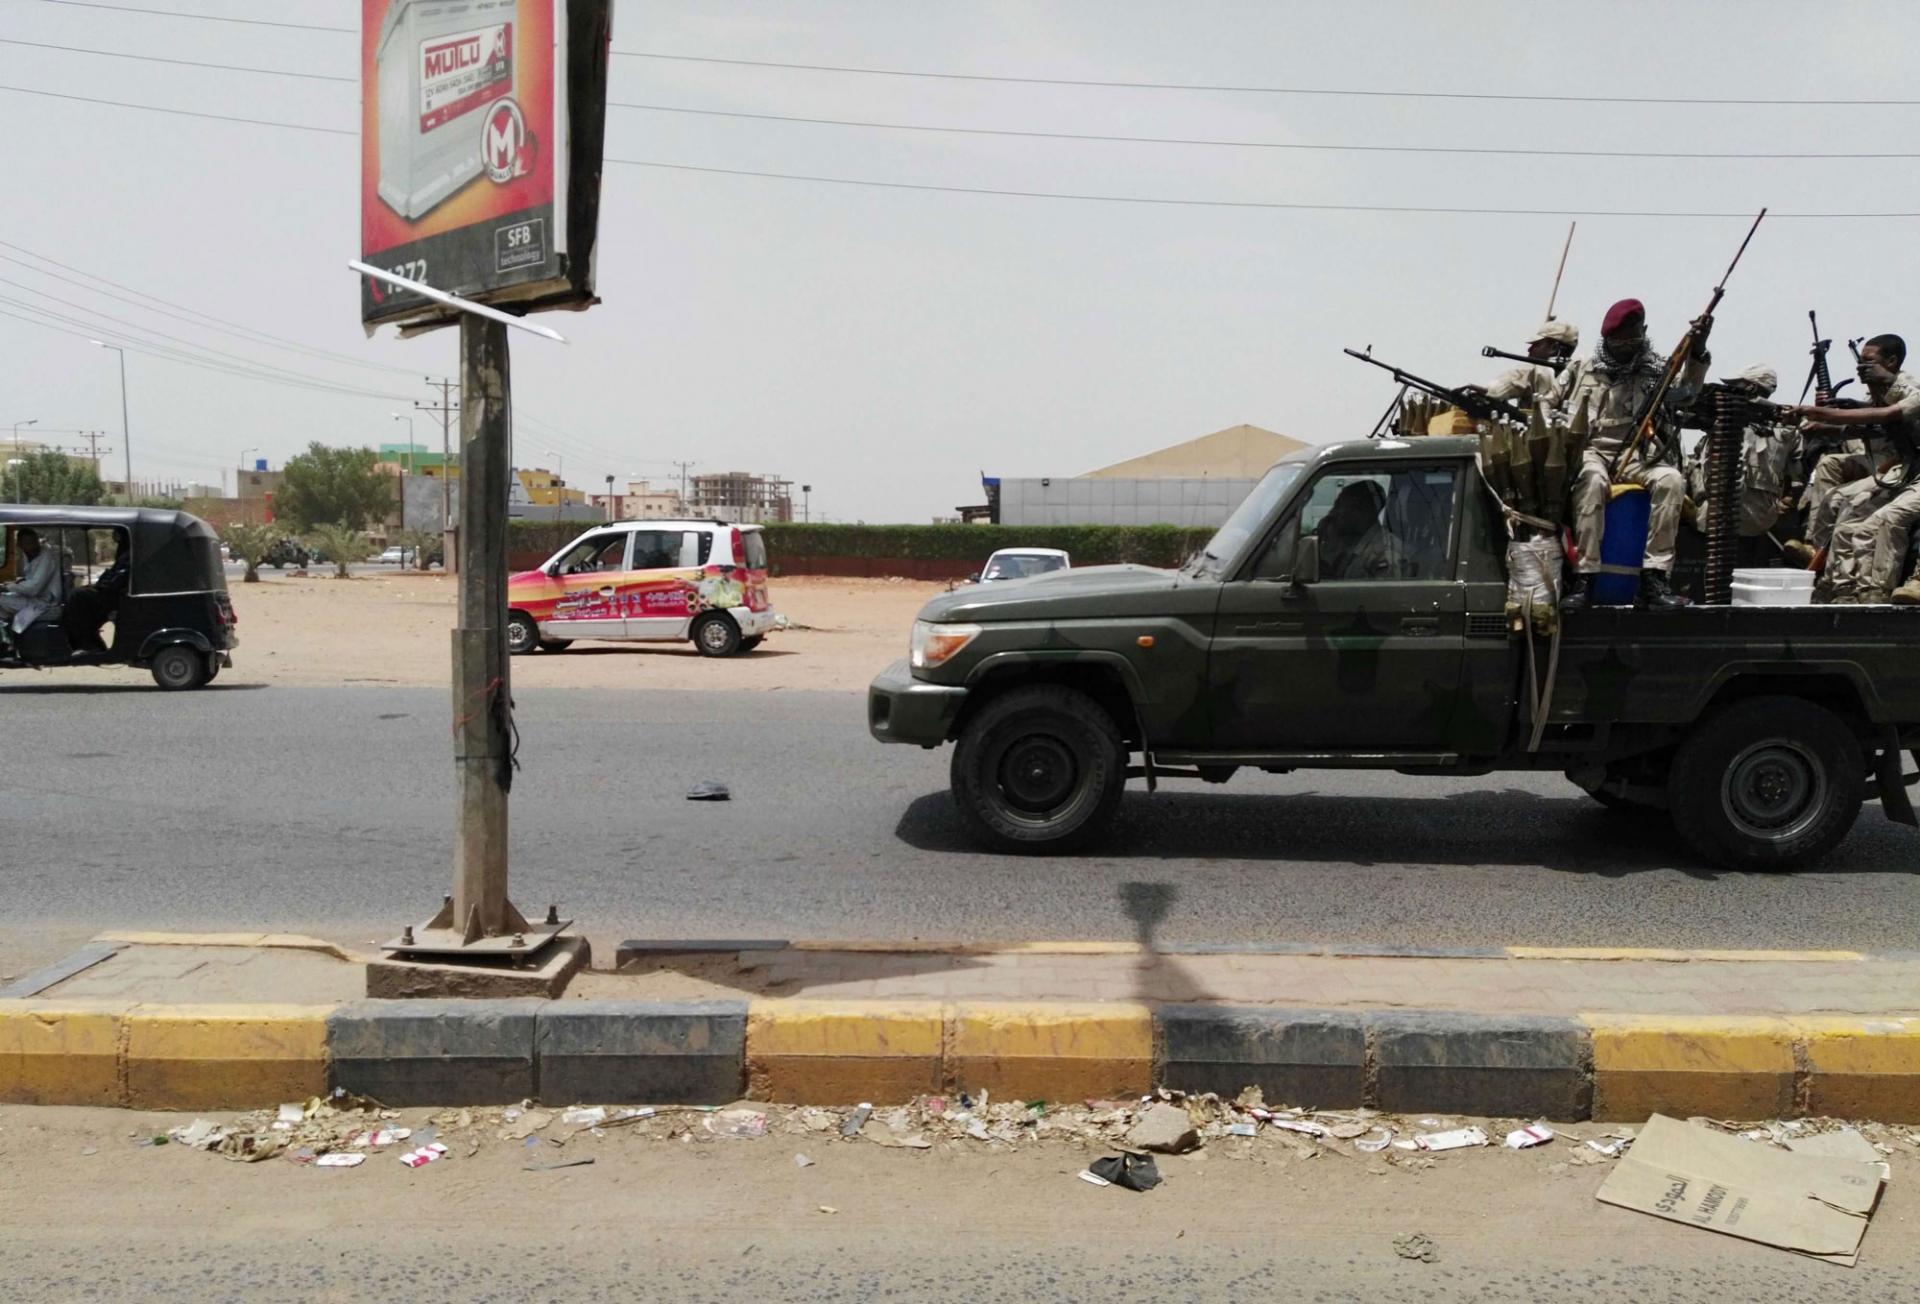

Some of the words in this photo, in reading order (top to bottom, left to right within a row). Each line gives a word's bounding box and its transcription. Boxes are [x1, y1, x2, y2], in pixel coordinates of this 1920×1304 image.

[424, 35, 480, 80] MUTLU
[508, 225, 531, 248] SFB
[500, 250, 541, 267] technology
[1697, 1183, 1728, 1215] HAMODY
[1691, 1213, 1713, 1225] AL
